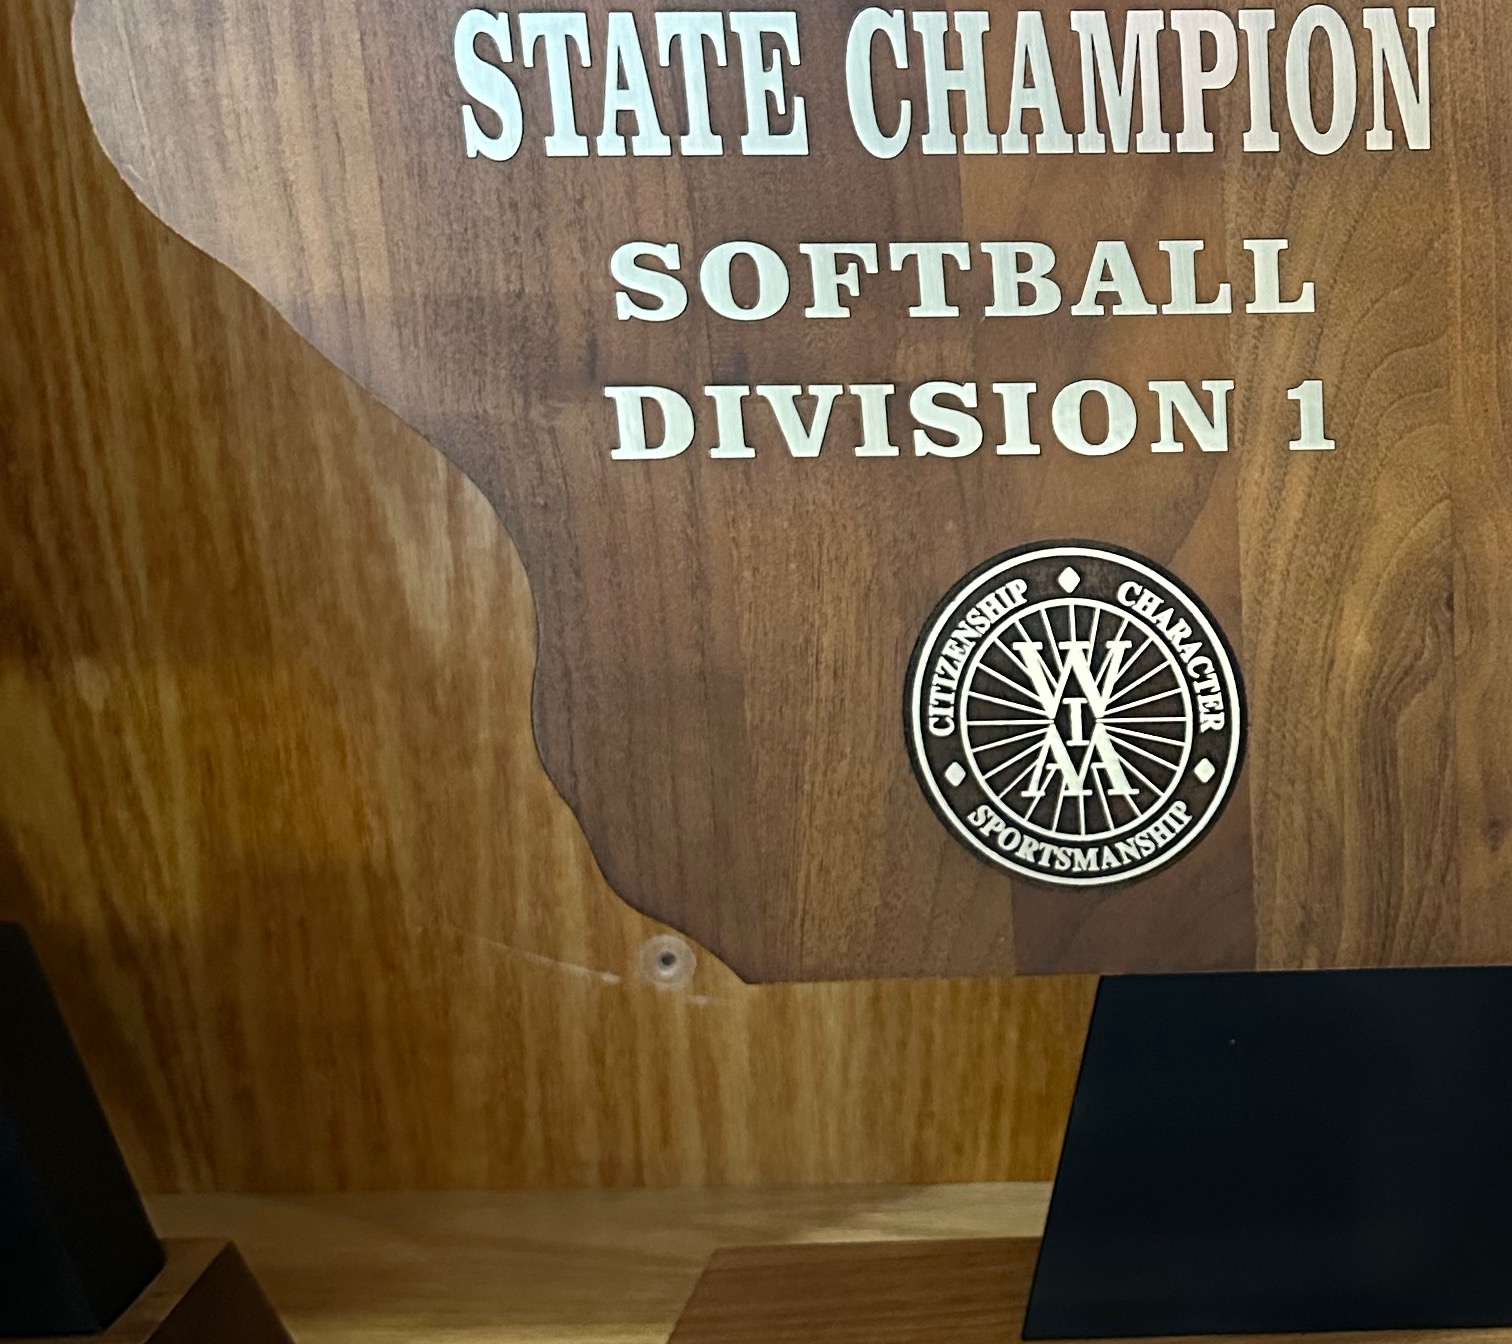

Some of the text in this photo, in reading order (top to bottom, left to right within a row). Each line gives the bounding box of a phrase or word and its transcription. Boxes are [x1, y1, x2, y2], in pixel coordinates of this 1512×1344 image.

[453, 3, 1436, 162] STATE CHAMPION
[609, 237, 1317, 323] SOFTBALL
[604, 378, 1336, 461] DIVISION 1
[929, 578, 1028, 737] CITIZENSHIP
[1117, 581, 1225, 733] CHARACTER
[968, 800, 1192, 871] SPORTSMANSHIP
